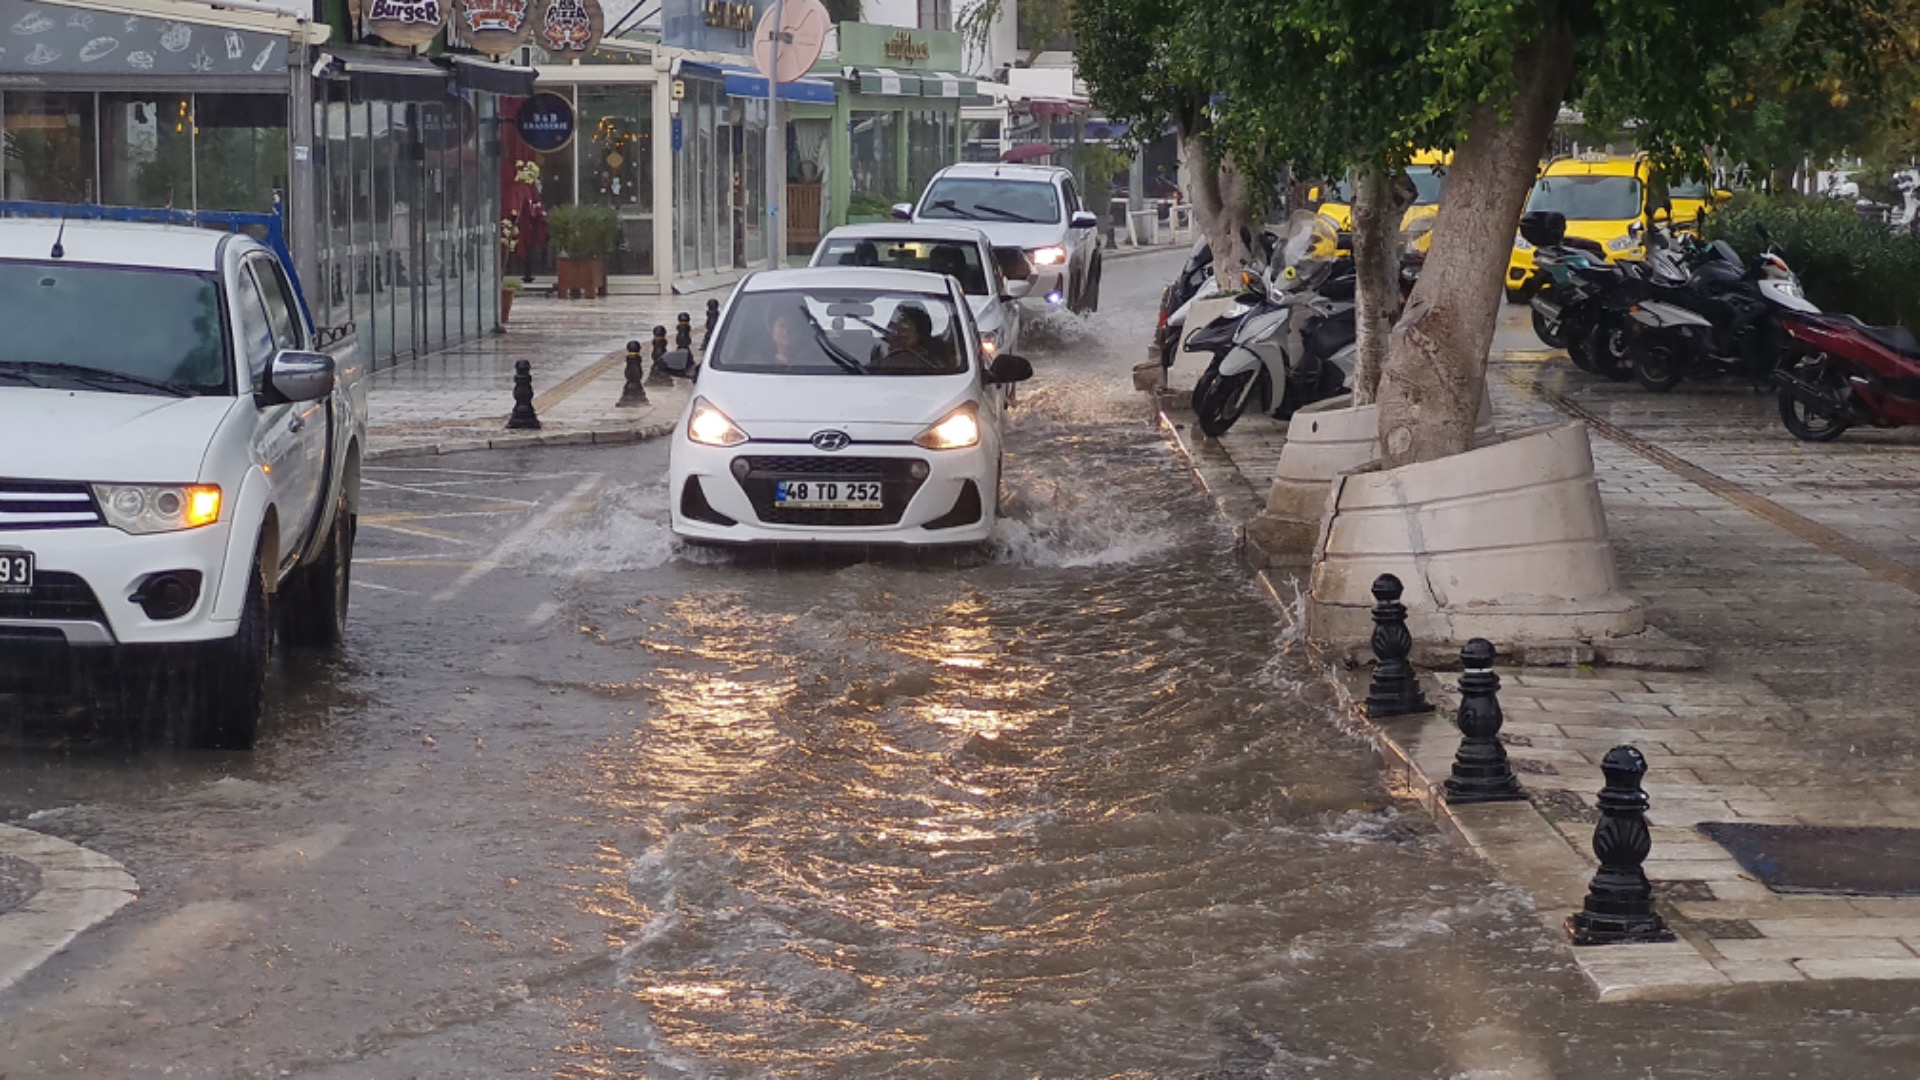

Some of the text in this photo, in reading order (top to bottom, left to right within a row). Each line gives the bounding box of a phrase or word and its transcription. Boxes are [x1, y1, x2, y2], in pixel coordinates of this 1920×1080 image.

[786, 483, 879, 501] 48 TD 252
[0, 557, 27, 582] 93
